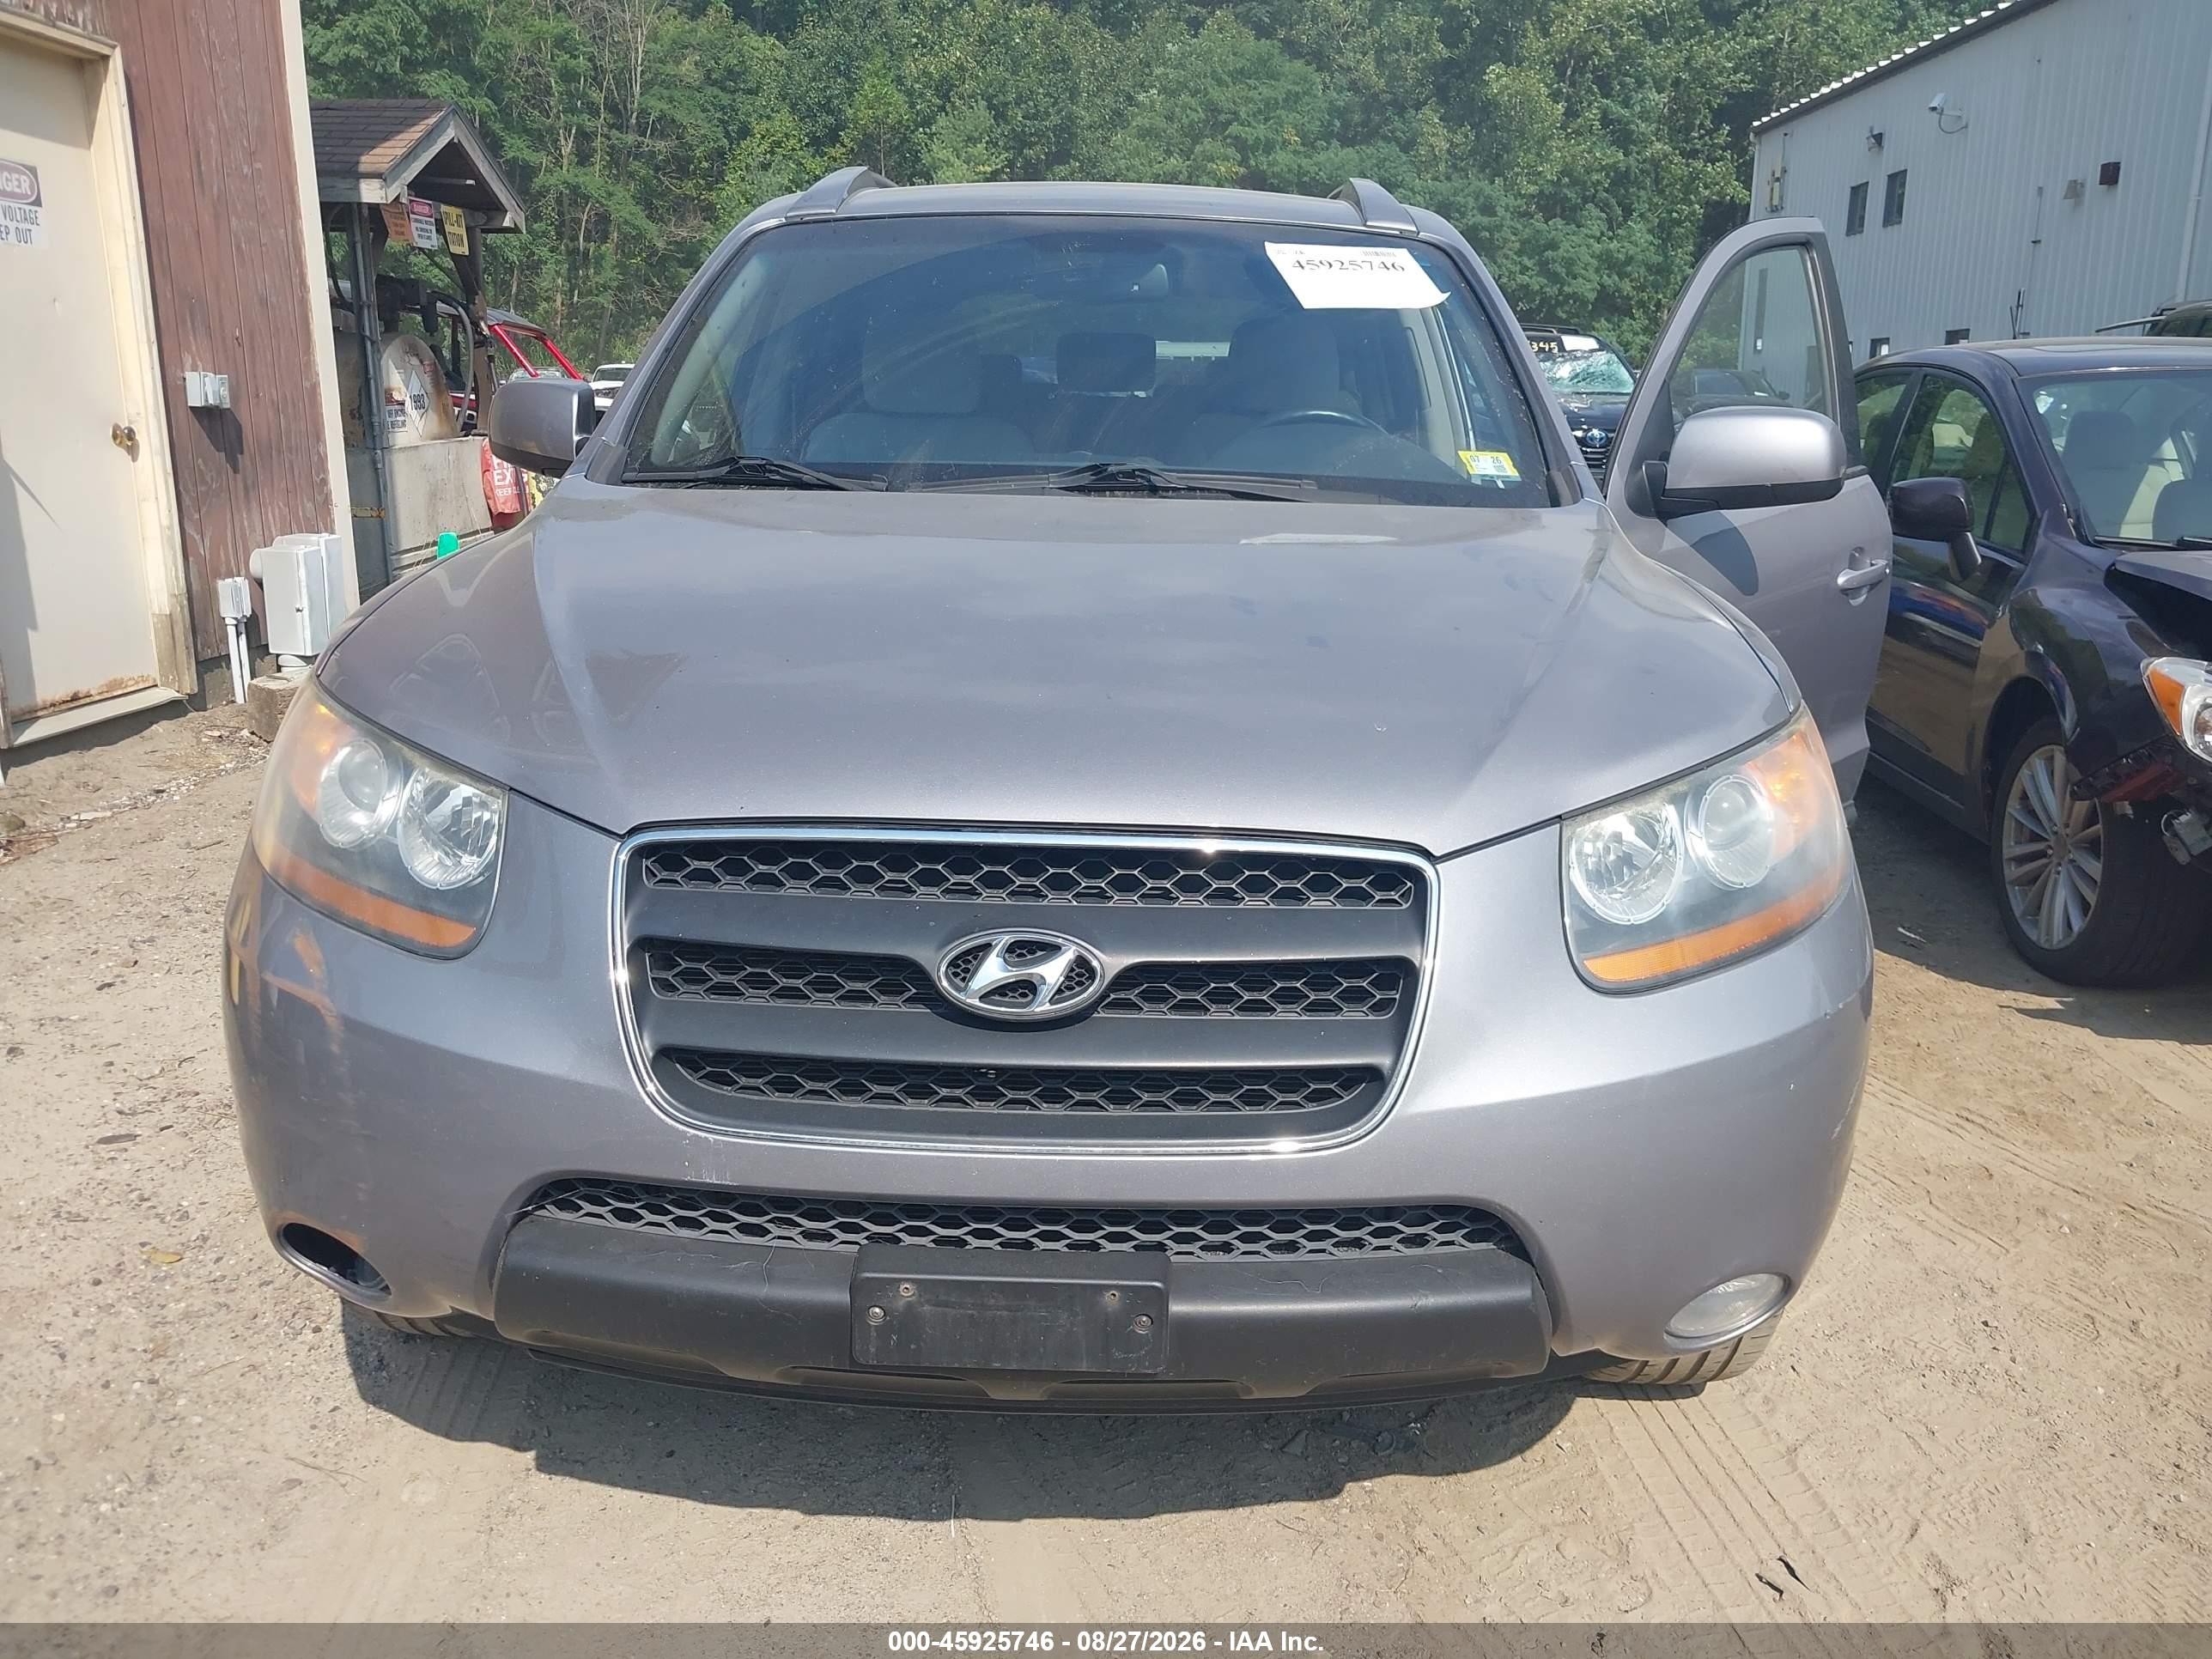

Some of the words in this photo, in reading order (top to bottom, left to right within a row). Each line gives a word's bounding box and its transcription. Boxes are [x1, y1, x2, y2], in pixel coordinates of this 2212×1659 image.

[1, 204, 40, 227] VOLTAGE
[15, 227, 33, 245] OUT
[1292, 259, 1405, 271] 45925746
[1530, 341, 1559, 353] 345
[410, 394, 426, 410] 1993
